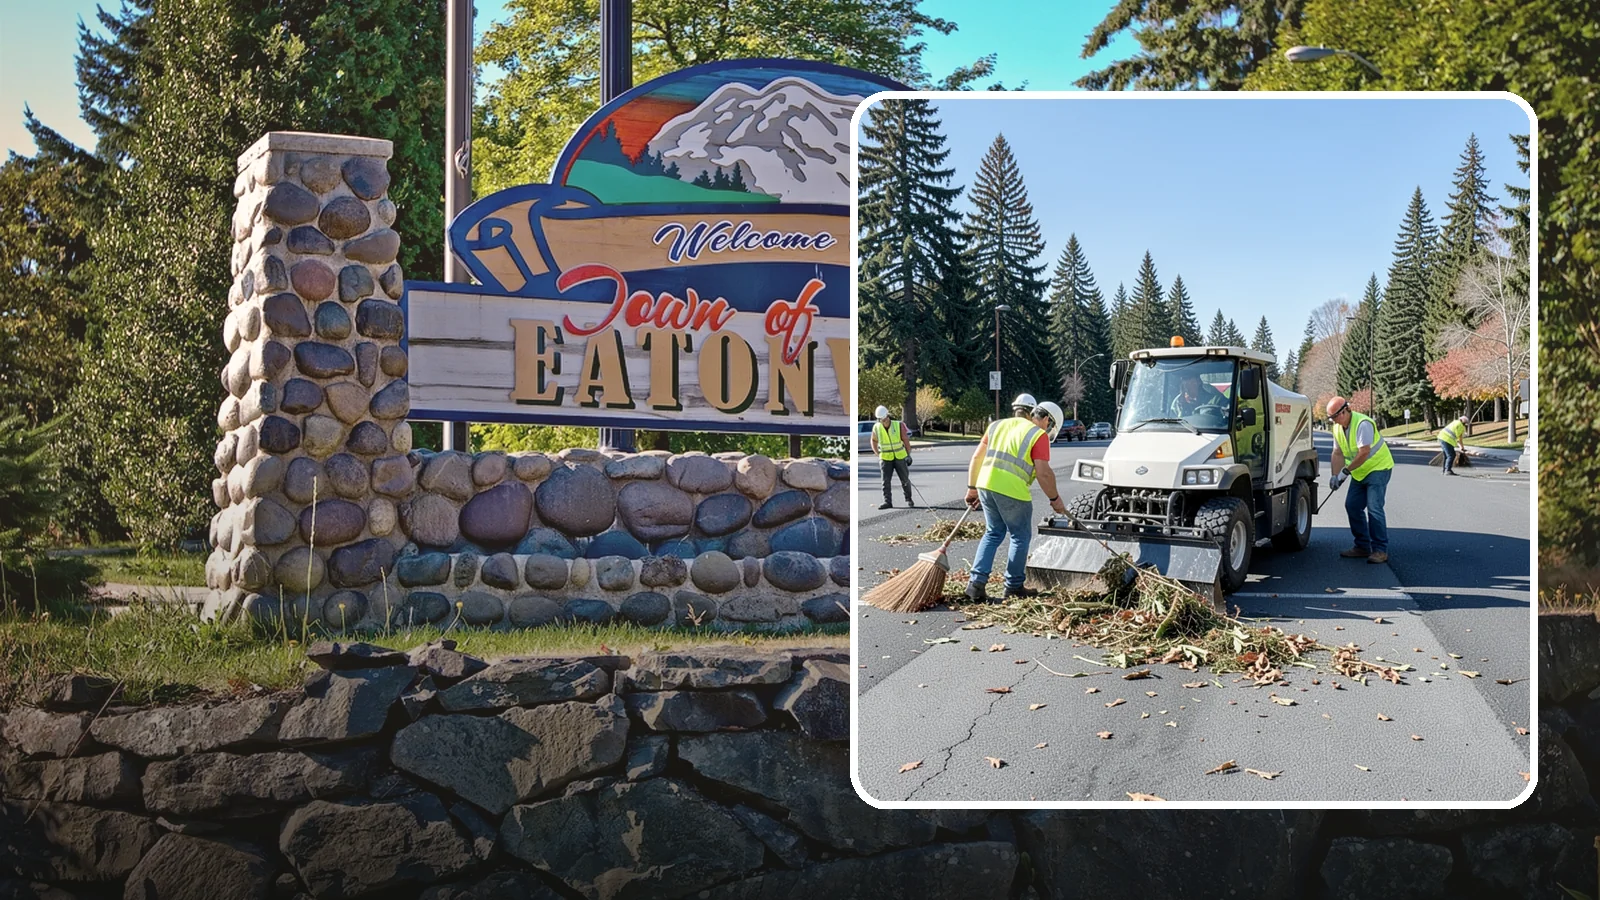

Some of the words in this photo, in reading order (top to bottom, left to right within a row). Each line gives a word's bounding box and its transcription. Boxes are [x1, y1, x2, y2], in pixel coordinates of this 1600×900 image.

[653, 220, 837, 263] Welcome
[557, 263, 737, 336] Town
[764, 279, 826, 366] of
